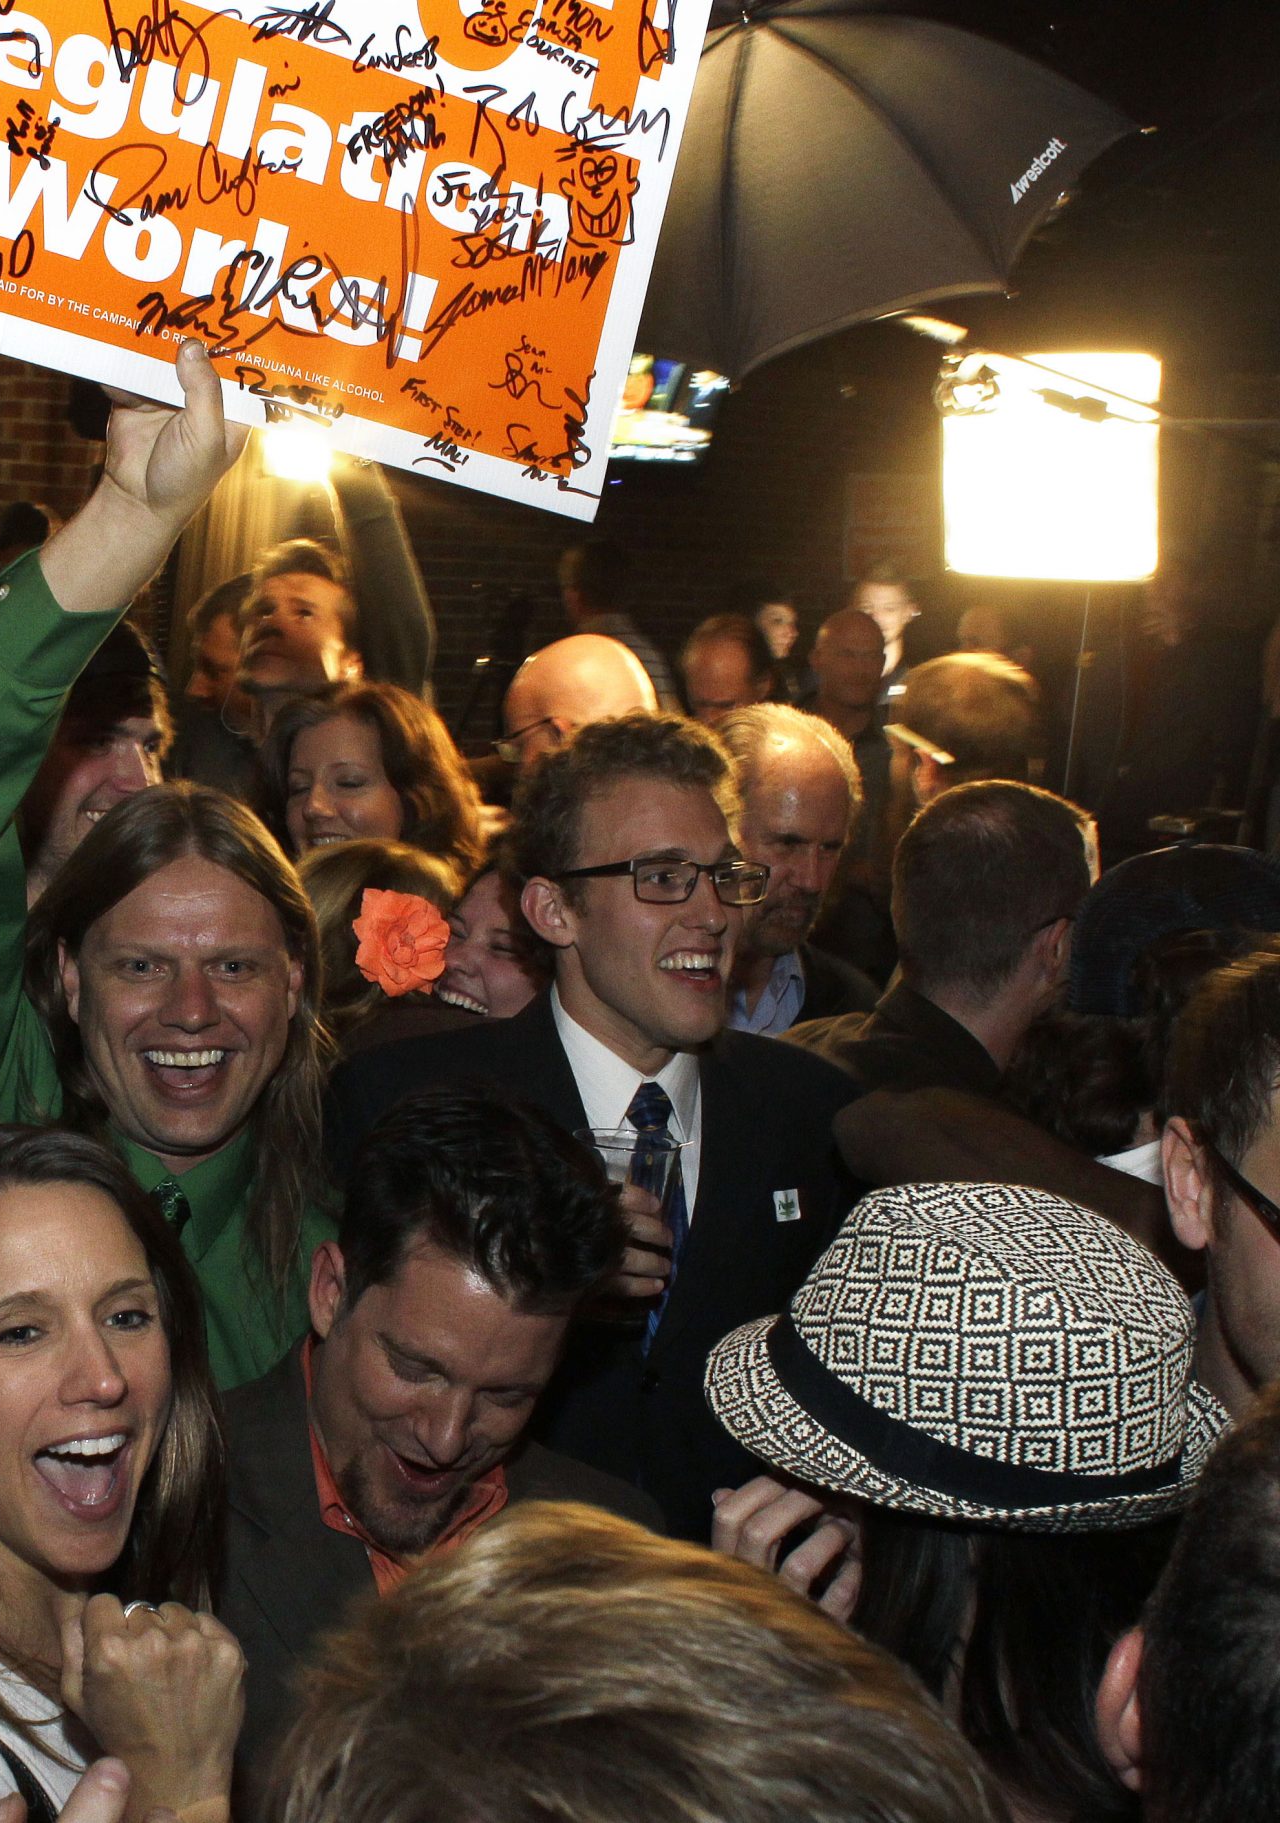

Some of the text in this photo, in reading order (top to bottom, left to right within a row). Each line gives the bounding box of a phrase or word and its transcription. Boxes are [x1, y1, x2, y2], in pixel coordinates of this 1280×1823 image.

[346, 73, 446, 165] FREEDOM!
[20, 285, 46, 302] FOR
[48, 294, 65, 308] BY
[68, 300, 91, 316] THE
[235, 351, 303, 379] MARIJUANA
[305, 371, 332, 387] LIKE
[333, 380, 386, 404] ALCOHOL
